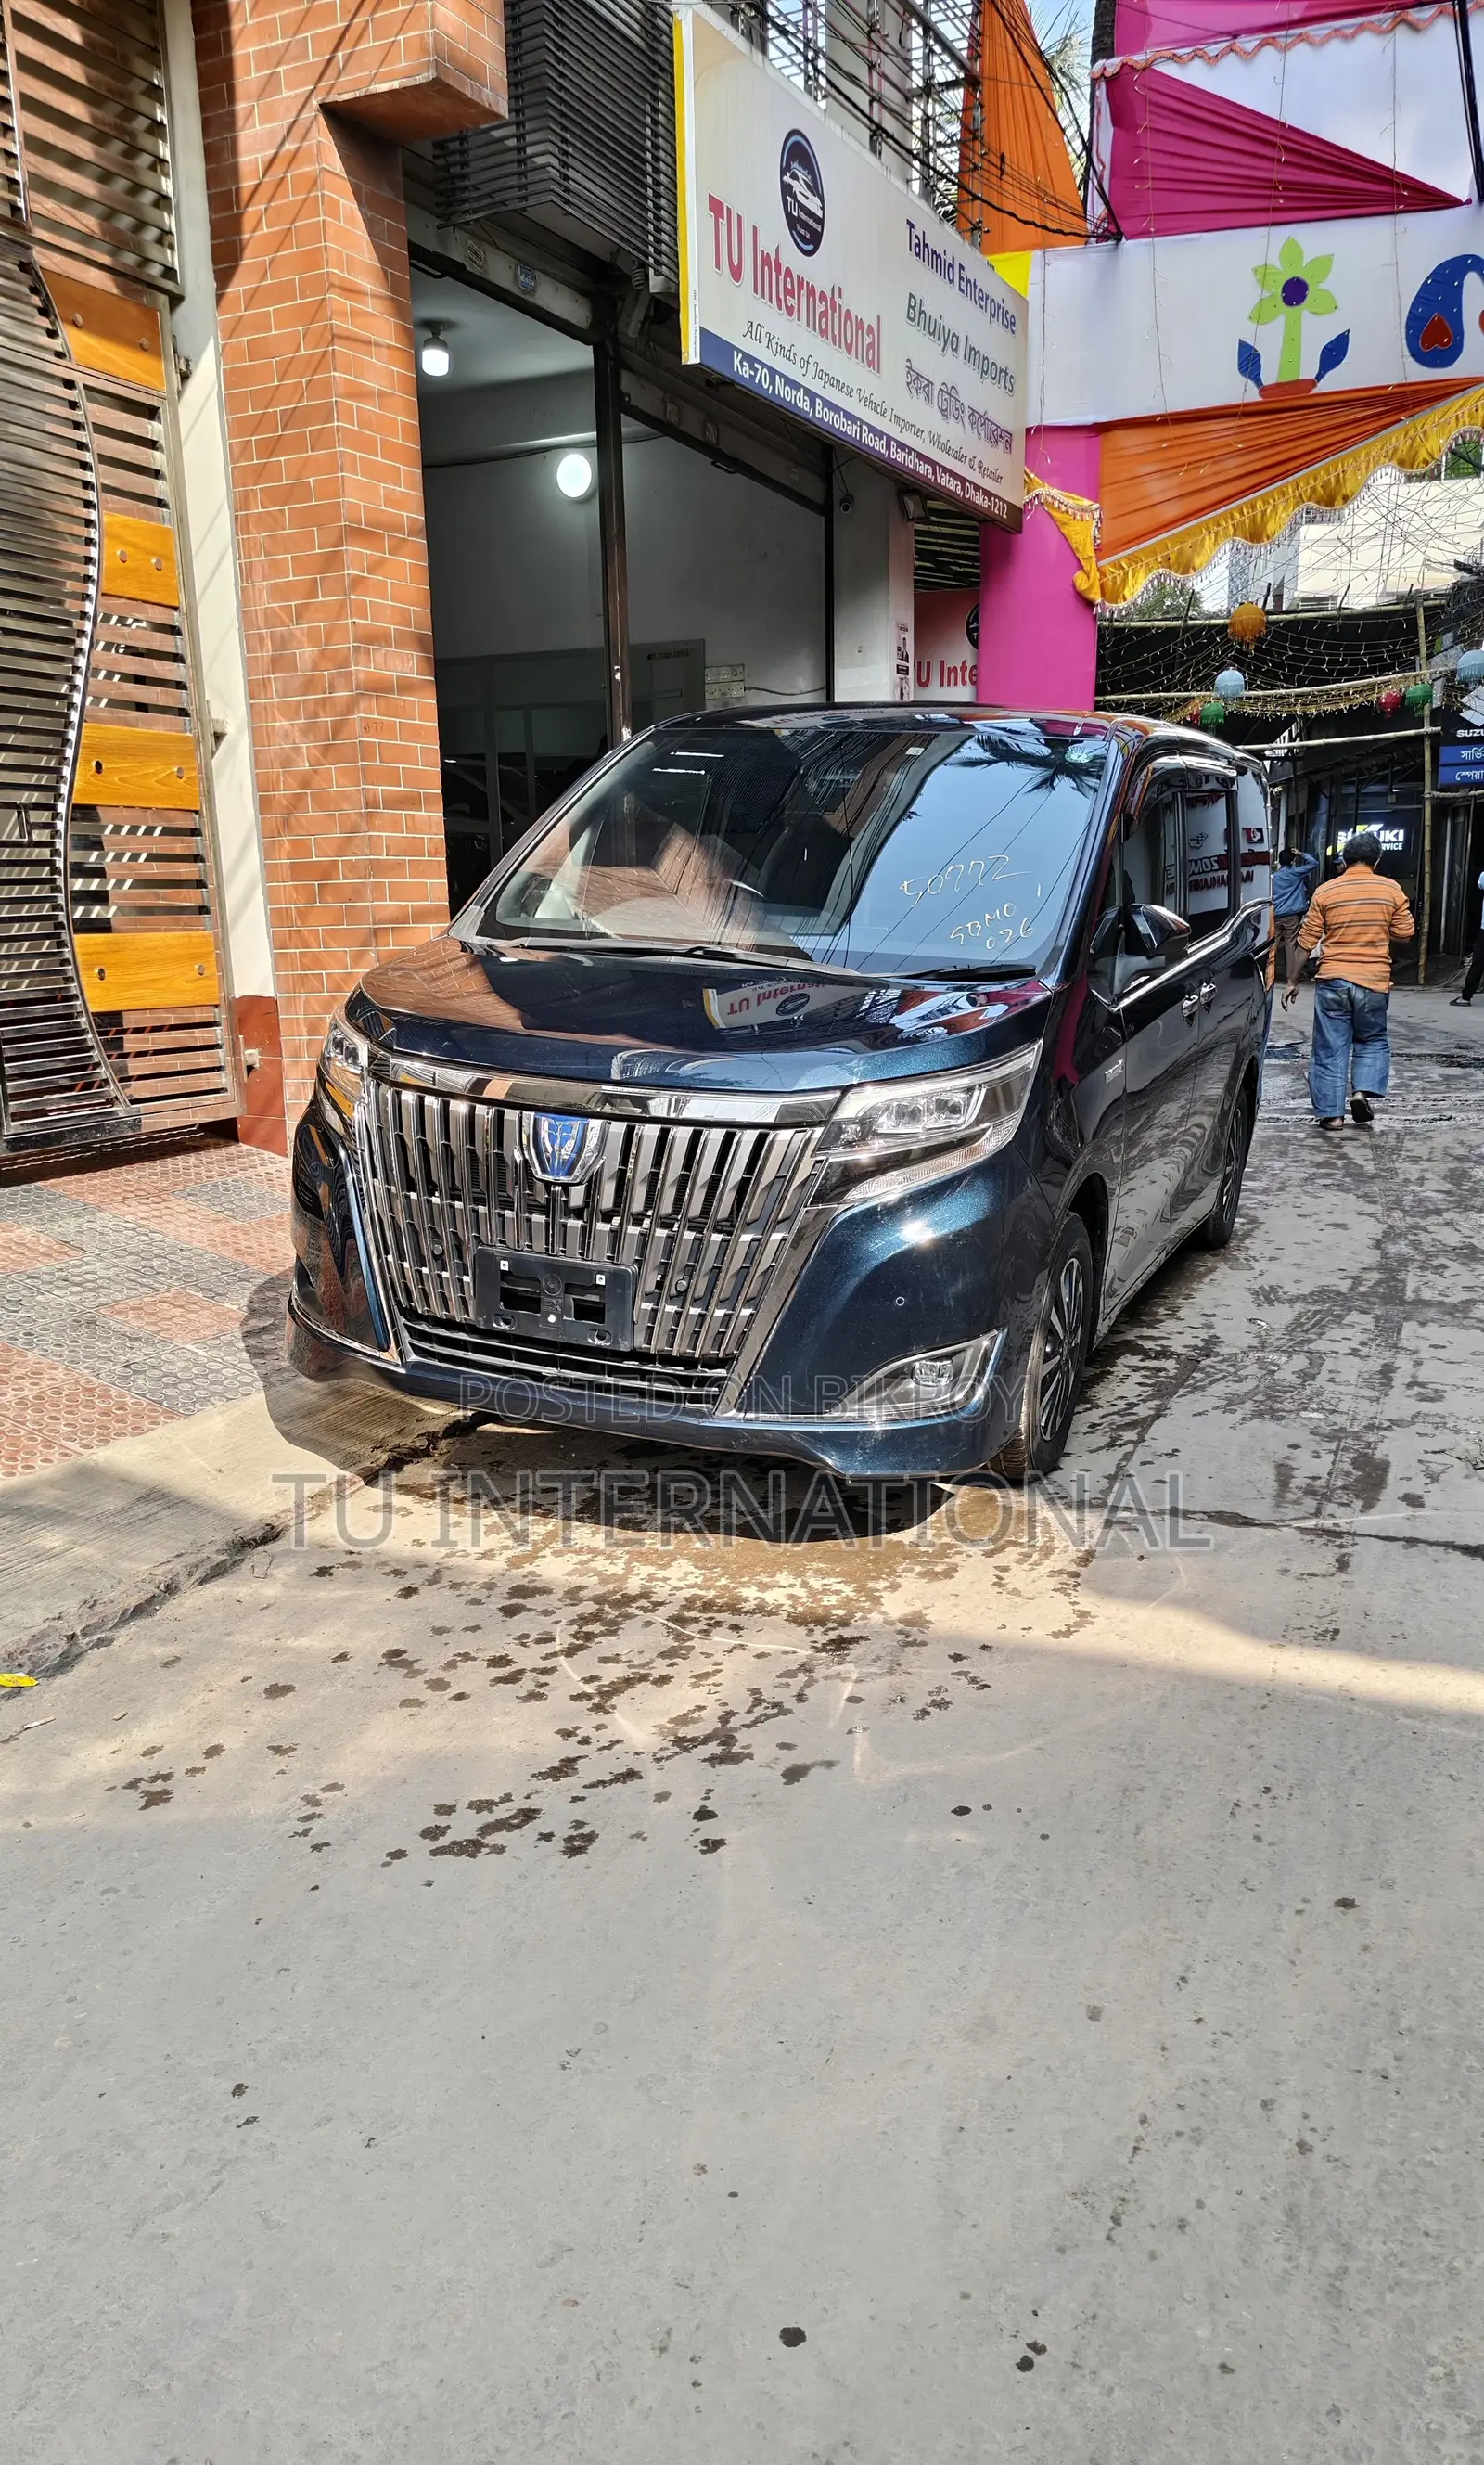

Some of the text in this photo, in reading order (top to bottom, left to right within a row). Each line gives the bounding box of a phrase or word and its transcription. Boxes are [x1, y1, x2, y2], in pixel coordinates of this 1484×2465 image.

[787, 195, 798, 217] TU
[708, 192, 744, 285] TU
[752, 223, 881, 376] International
[906, 218, 1016, 335] Tahmid Enterprise
[906, 292, 1015, 393] Bhuiya Imports
[733, 351, 1007, 519] Ka-70, Norda, Borobari Road, Baridhara, Vatara, Dhaka-1212
[743, 320, 1003, 484] All Kinds of Japanese Vehicle Importer, Wholesaler & Retailer
[906, 358, 934, 405] ইকরা
[937, 381, 966, 430] ট্রেডিং
[914, 660, 931, 687] U
[1460, 747, 1484, 761] সার্ভি
